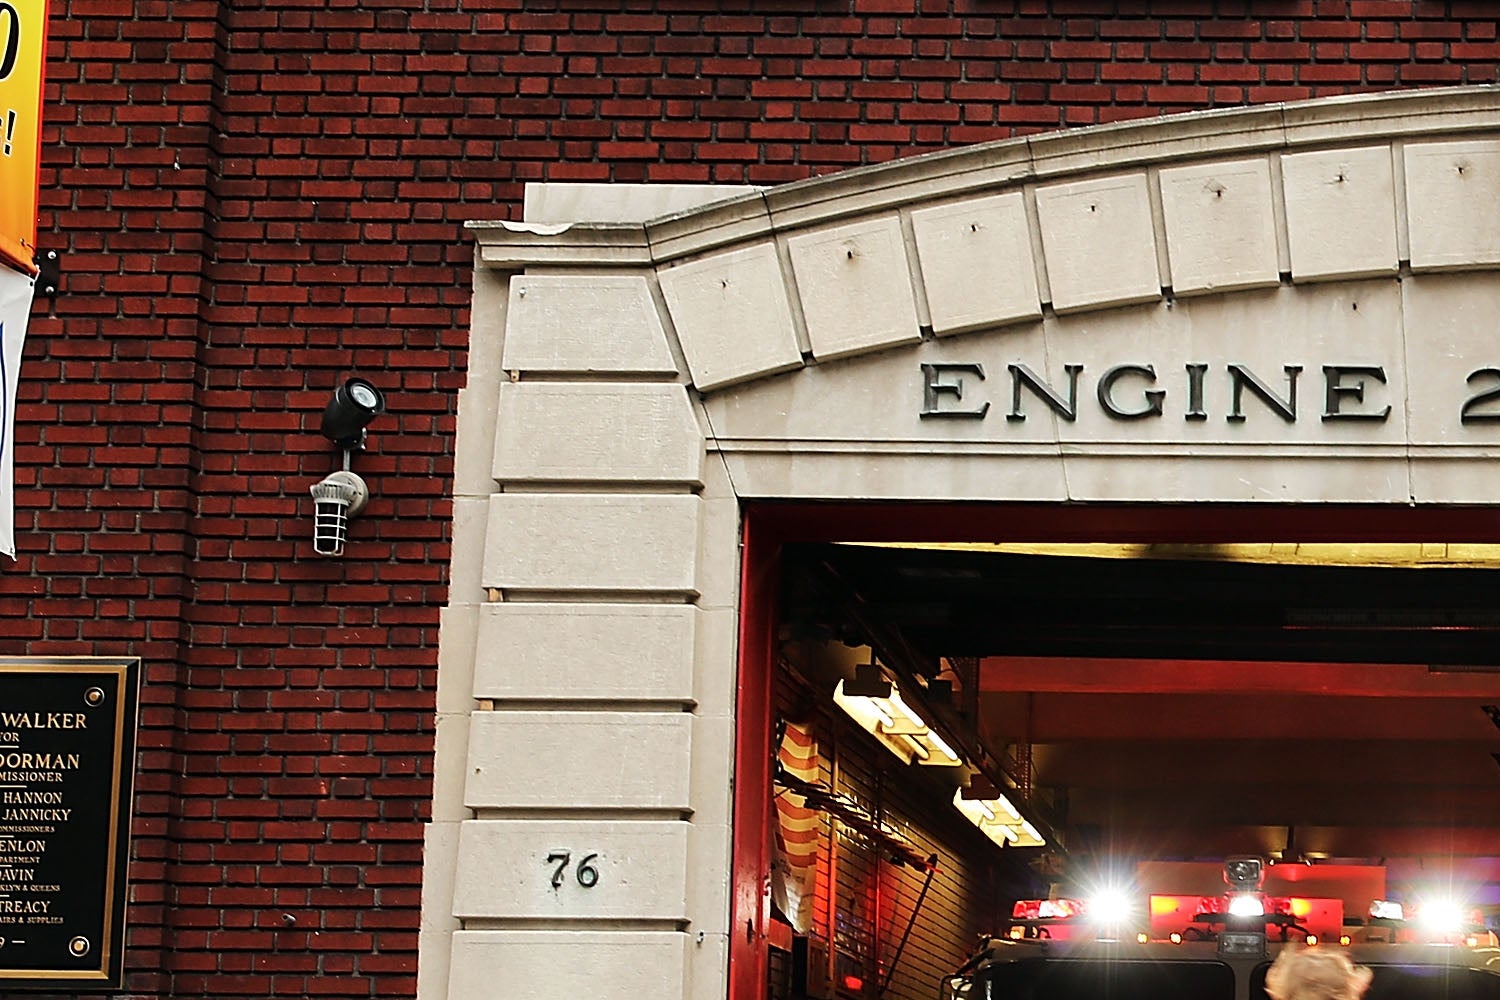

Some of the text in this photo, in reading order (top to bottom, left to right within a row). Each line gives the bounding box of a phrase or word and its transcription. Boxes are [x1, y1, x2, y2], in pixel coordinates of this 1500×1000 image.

[919, 362, 1392, 422] ENGINE
[1, 712, 87, 729] WALKER
[3, 791, 63, 804] HANNON
[1, 808, 72, 821] JANNICKY
[0, 868, 35, 881] AVIN
[546, 852, 599, 889] 76
